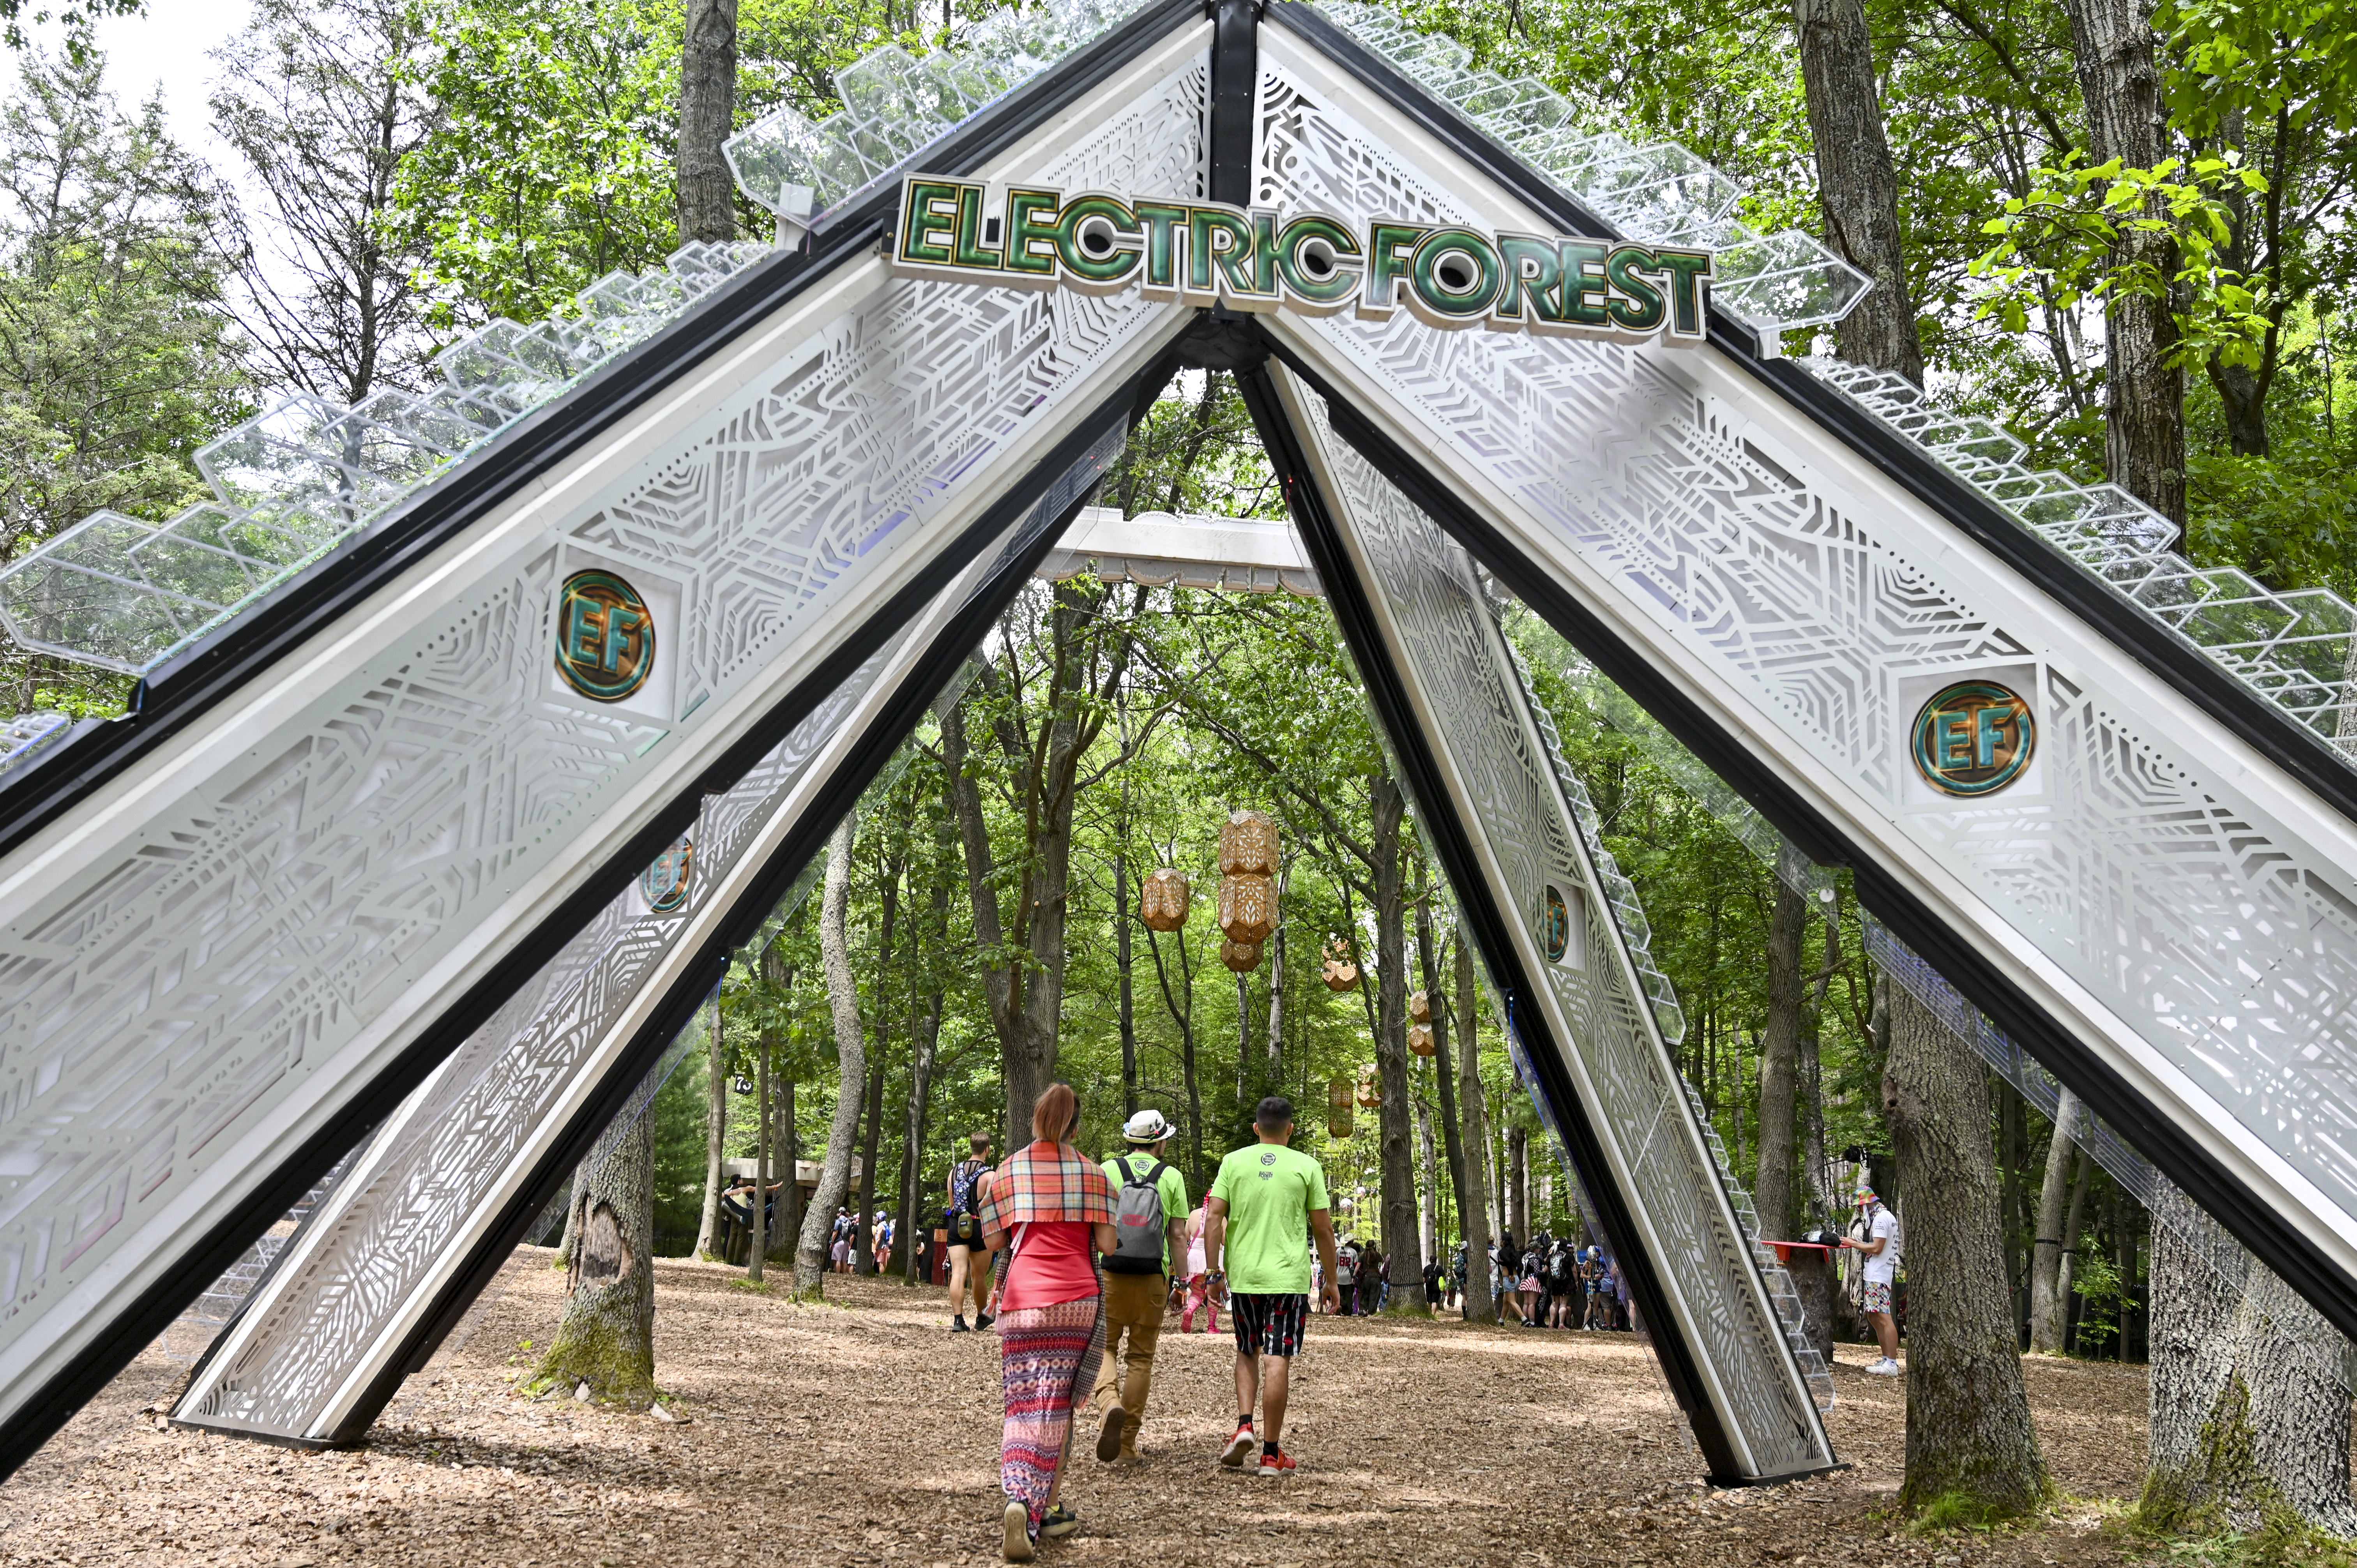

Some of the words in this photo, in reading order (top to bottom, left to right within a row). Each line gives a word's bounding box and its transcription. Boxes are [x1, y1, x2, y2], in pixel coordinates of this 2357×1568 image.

[898, 178, 1364, 304] ELECTRIC
[1365, 222, 1711, 336] FOREST
[567, 595, 646, 675] EF
[1934, 703, 2019, 772] EF
